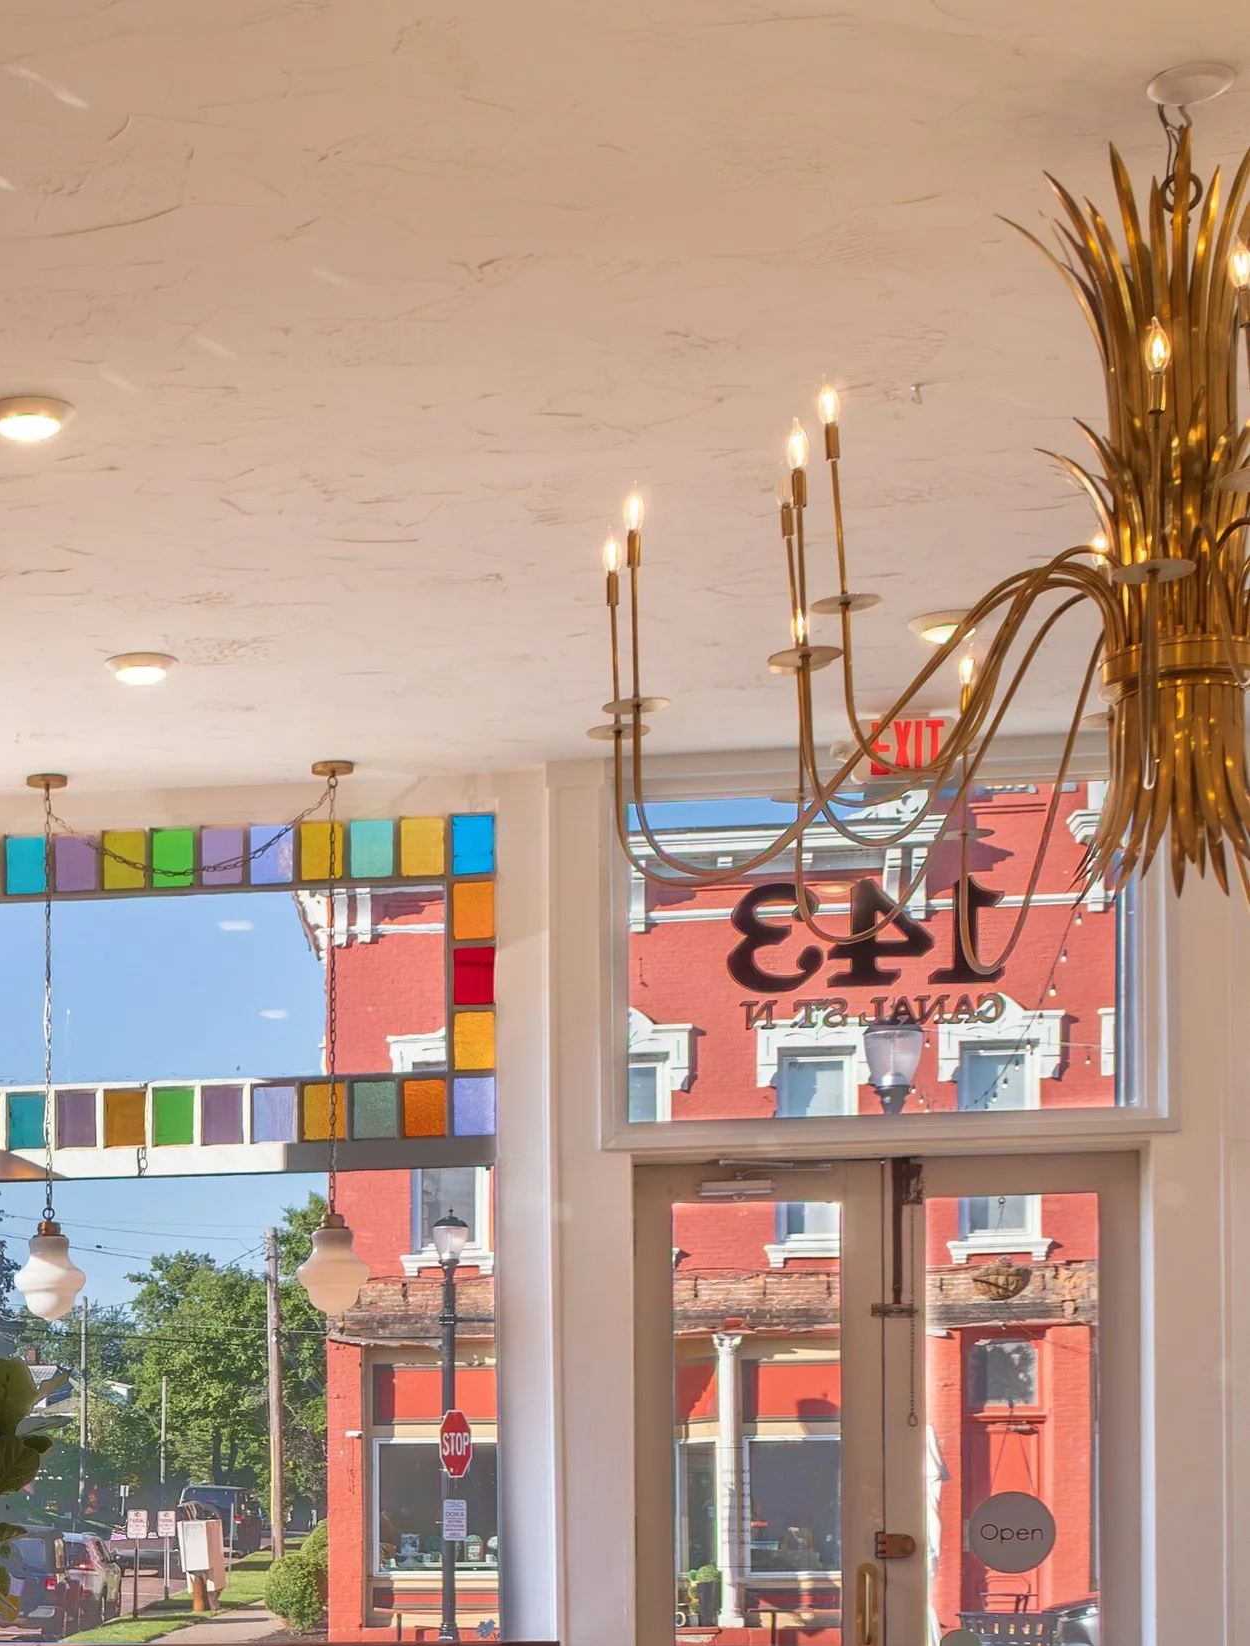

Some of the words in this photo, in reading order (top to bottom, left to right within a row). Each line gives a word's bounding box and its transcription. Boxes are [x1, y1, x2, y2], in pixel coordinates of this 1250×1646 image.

[870, 719, 945, 775] EXIT
[442, 1432, 470, 1456] STOP
[980, 1522, 1043, 1543] Open
